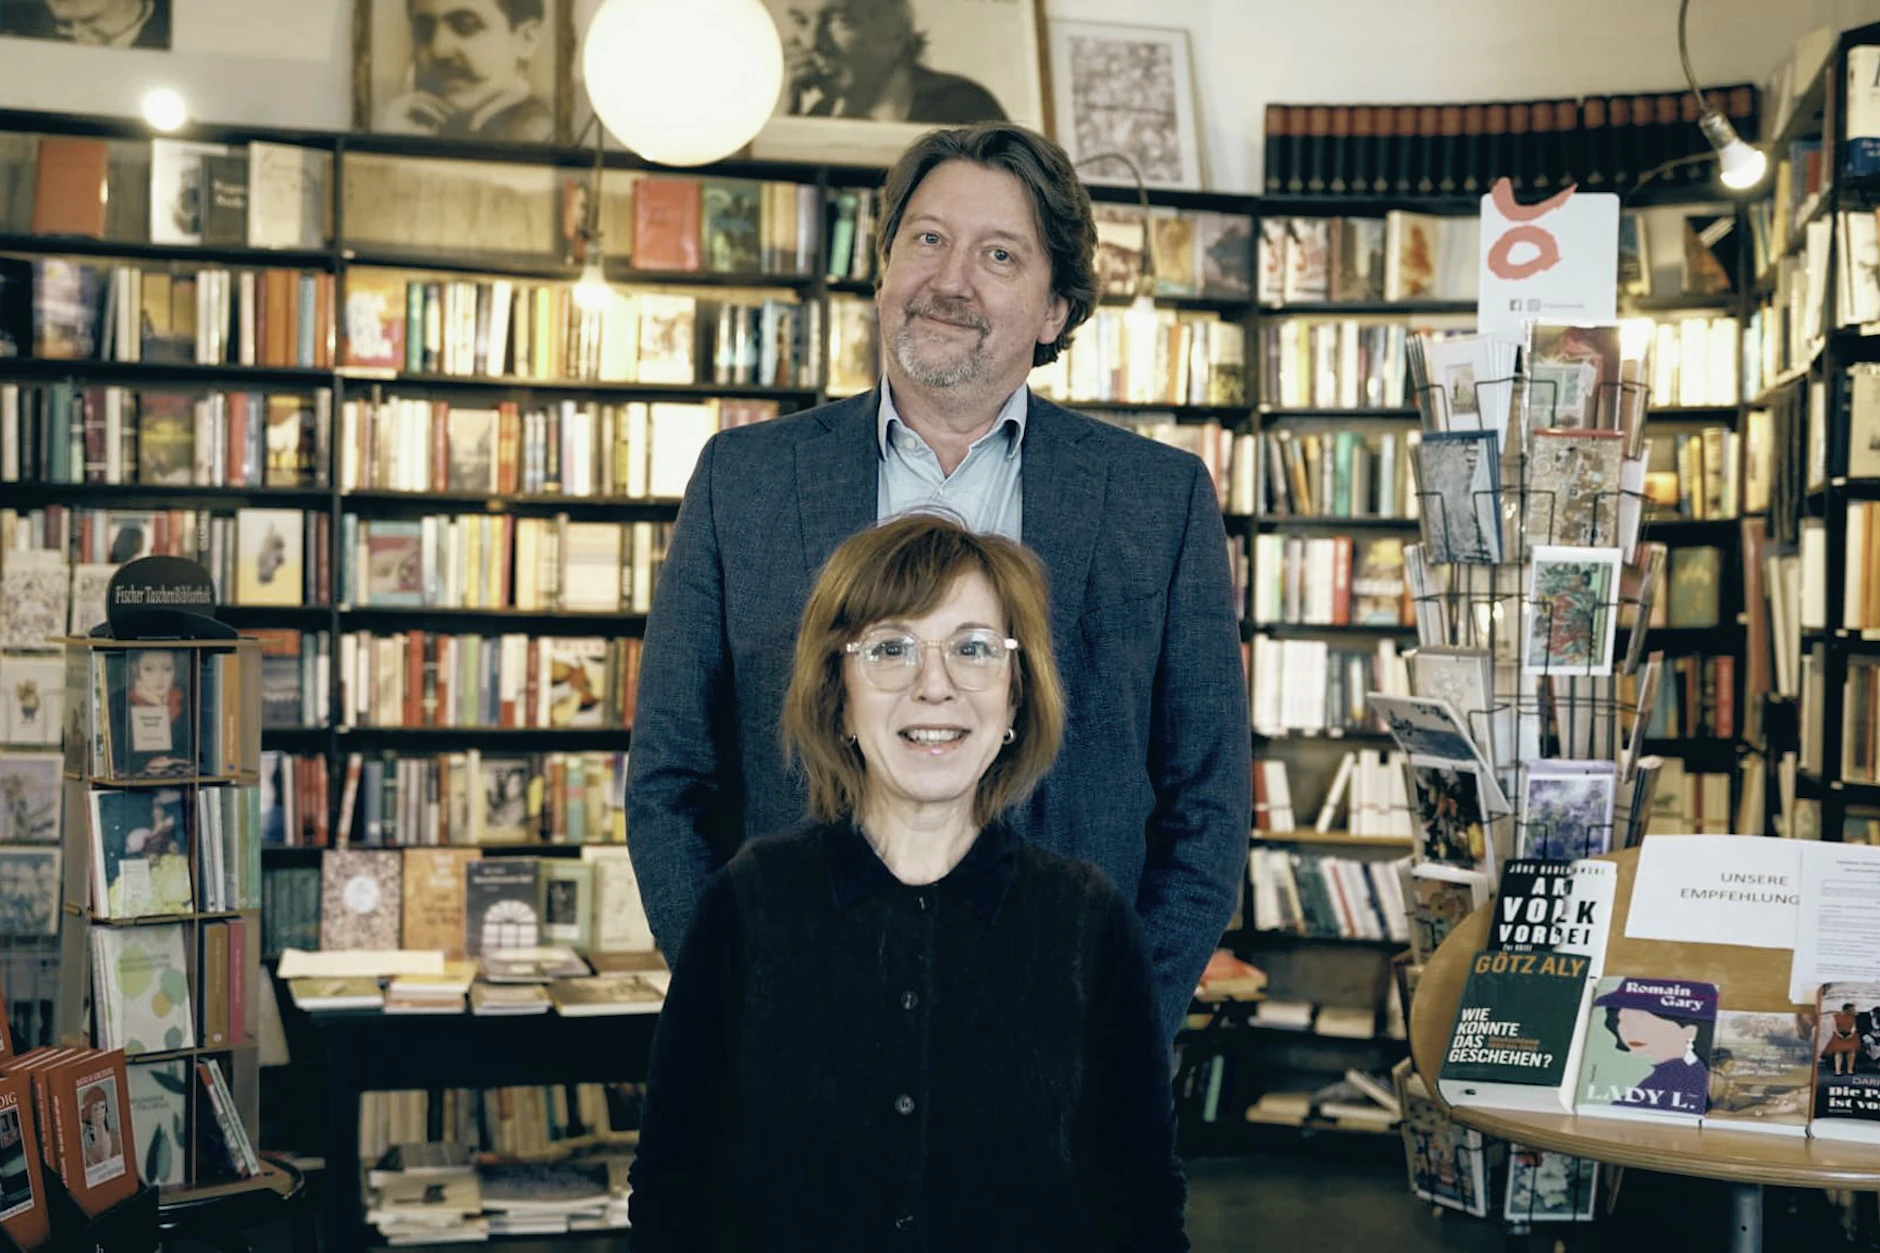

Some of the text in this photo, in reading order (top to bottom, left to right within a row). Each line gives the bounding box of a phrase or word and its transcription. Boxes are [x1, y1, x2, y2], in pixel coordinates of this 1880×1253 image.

[115, 584, 144, 604] Fischer
[1720, 872, 1789, 886] UNSERE
[1680, 888, 1800, 905] EMPFEHLUNG
[1503, 896, 1597, 924] VOLK
[1499, 923, 1590, 945] VORBEI
[1474, 952, 1585, 977] GÖTZ ALY
[1625, 982, 1692, 997] Romain
[1660, 995, 1704, 1011] Gary
[1461, 1007, 1491, 1022] WIE
[1456, 1021, 1520, 1037] KONNTE
[1452, 1035, 1485, 1049] DAS
[1449, 1049, 1553, 1068] GESCHEHEN?
[1586, 1084, 1696, 1109] LADY L.
[1828, 1086, 1860, 1098] Die
[1828, 1097, 1852, 1108] ist
